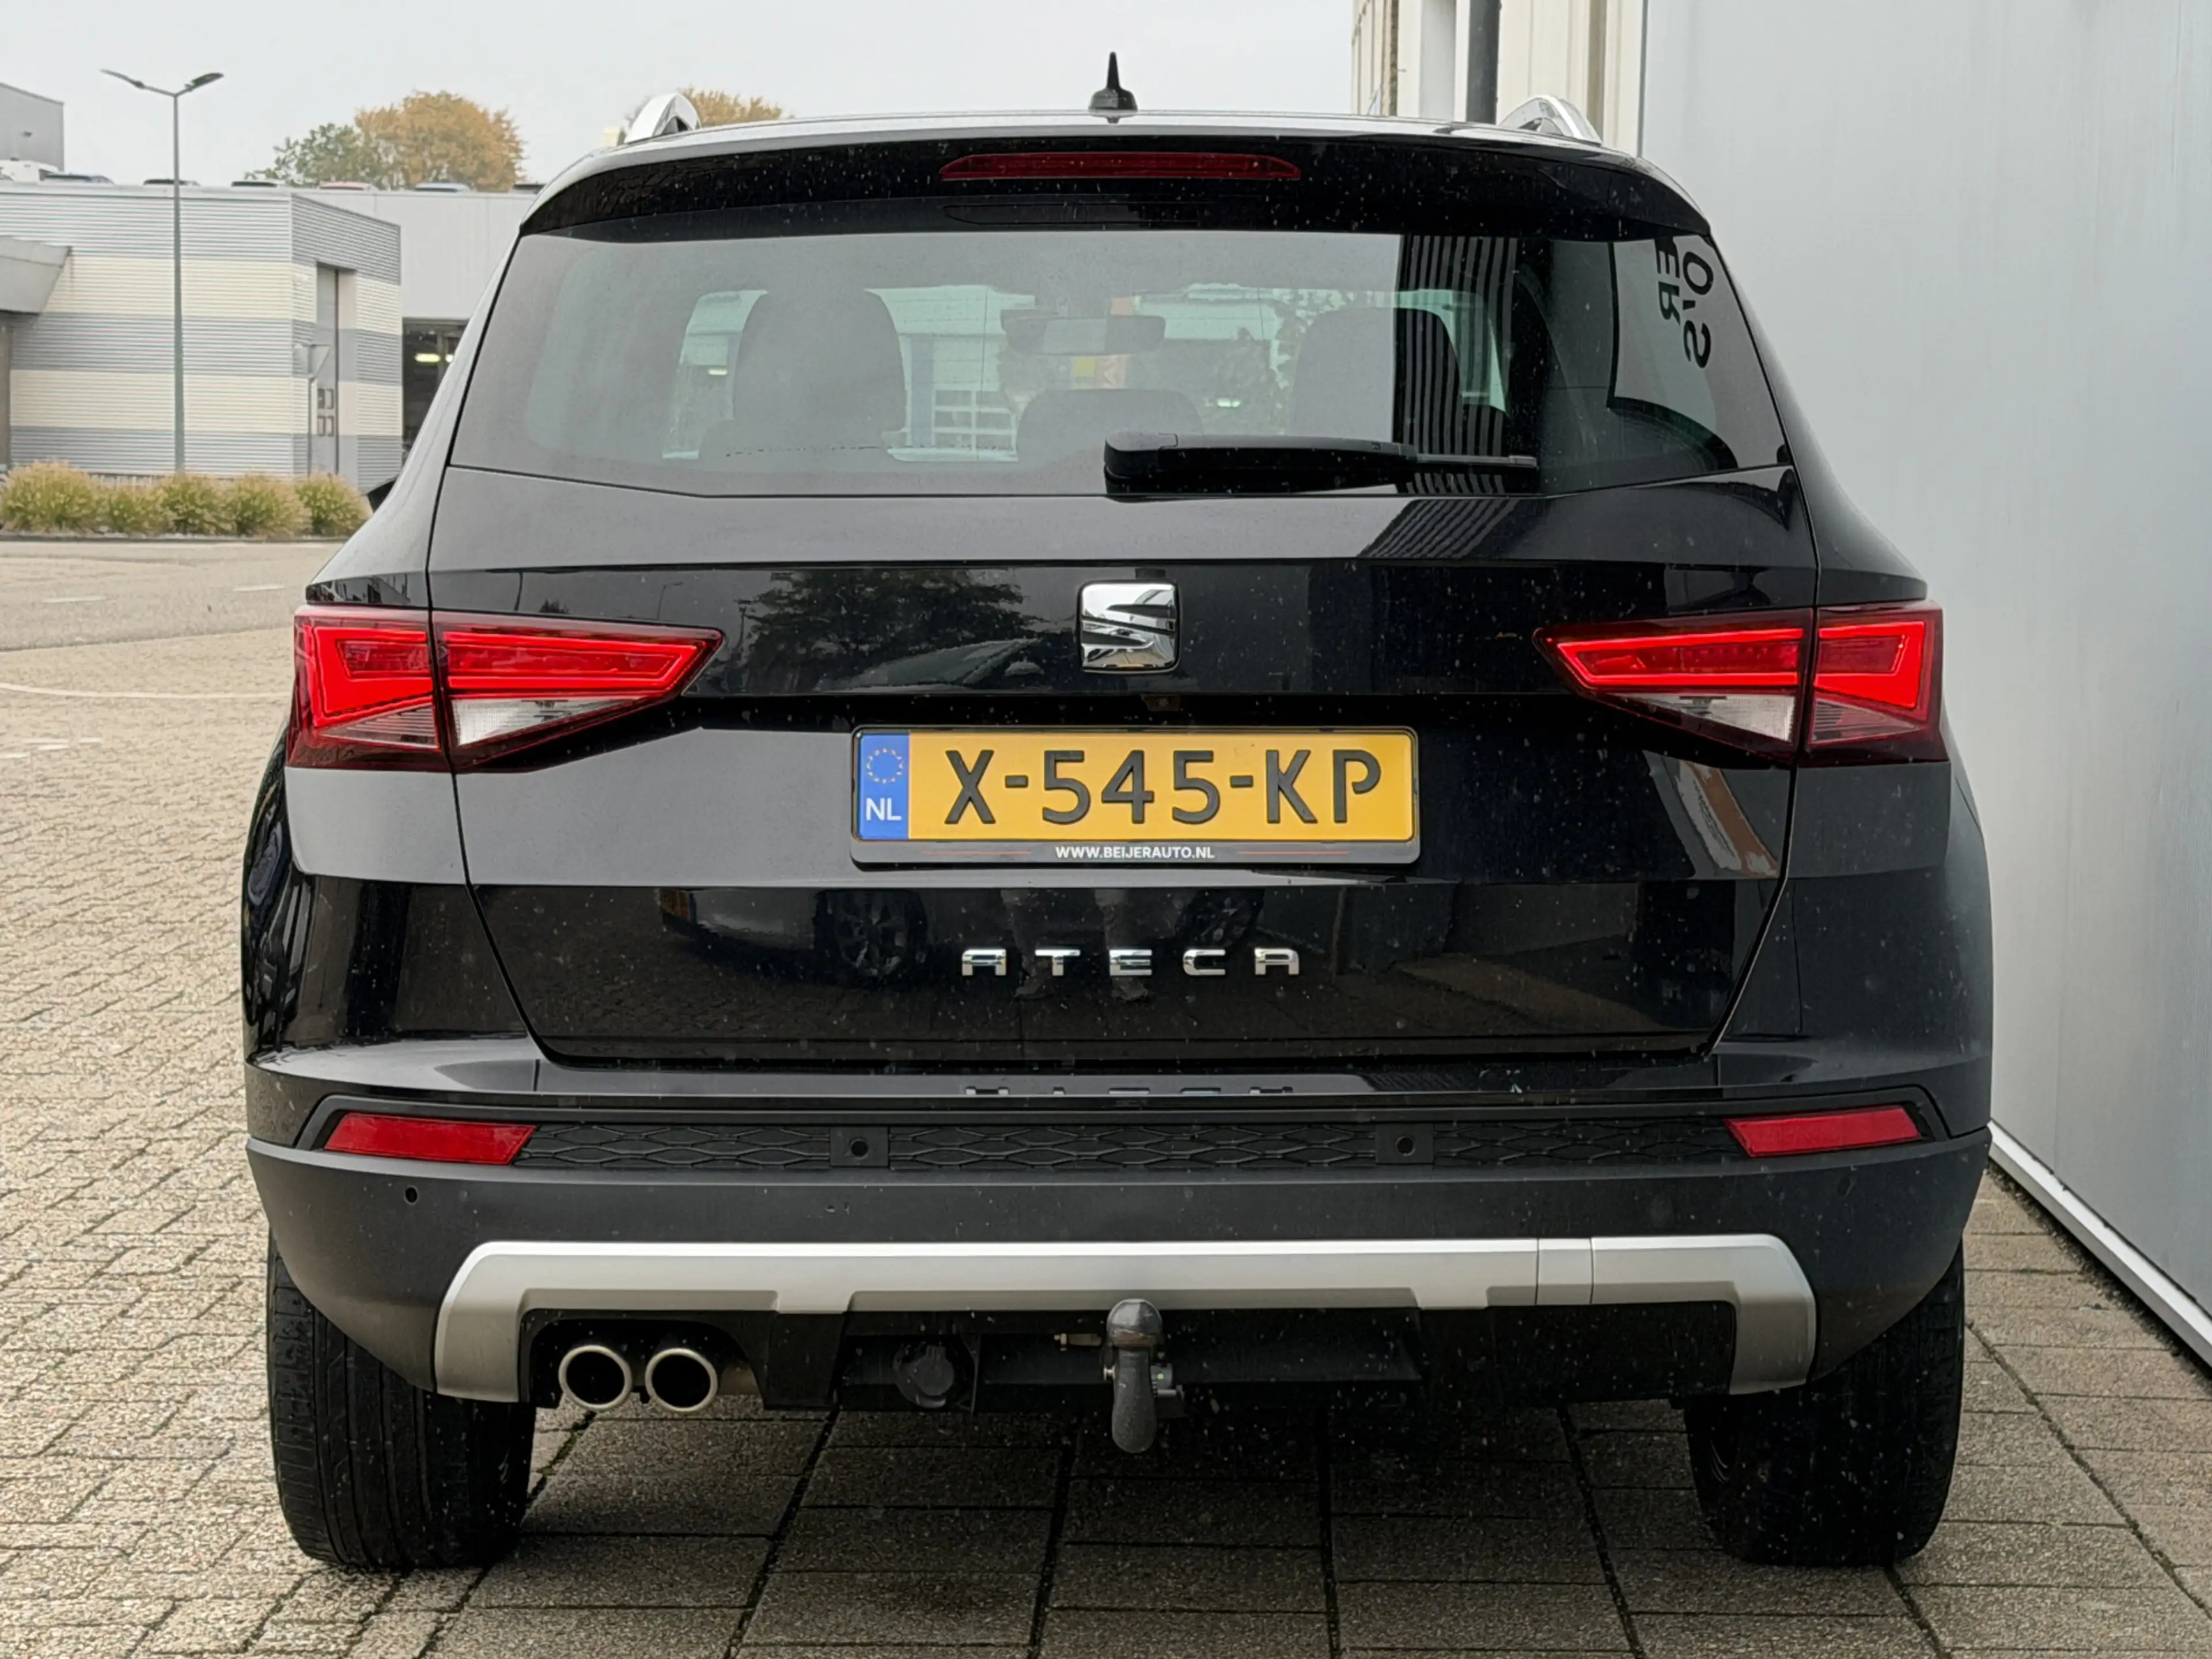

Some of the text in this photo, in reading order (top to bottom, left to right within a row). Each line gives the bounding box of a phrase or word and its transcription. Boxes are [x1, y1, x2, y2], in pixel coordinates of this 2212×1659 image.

[944, 749, 1381, 825] X-545-KP
[866, 797, 903, 821] NL
[1054, 845, 1215, 859] WWW.BEIJERAUTO.NL
[961, 948, 1300, 976] ATECA
